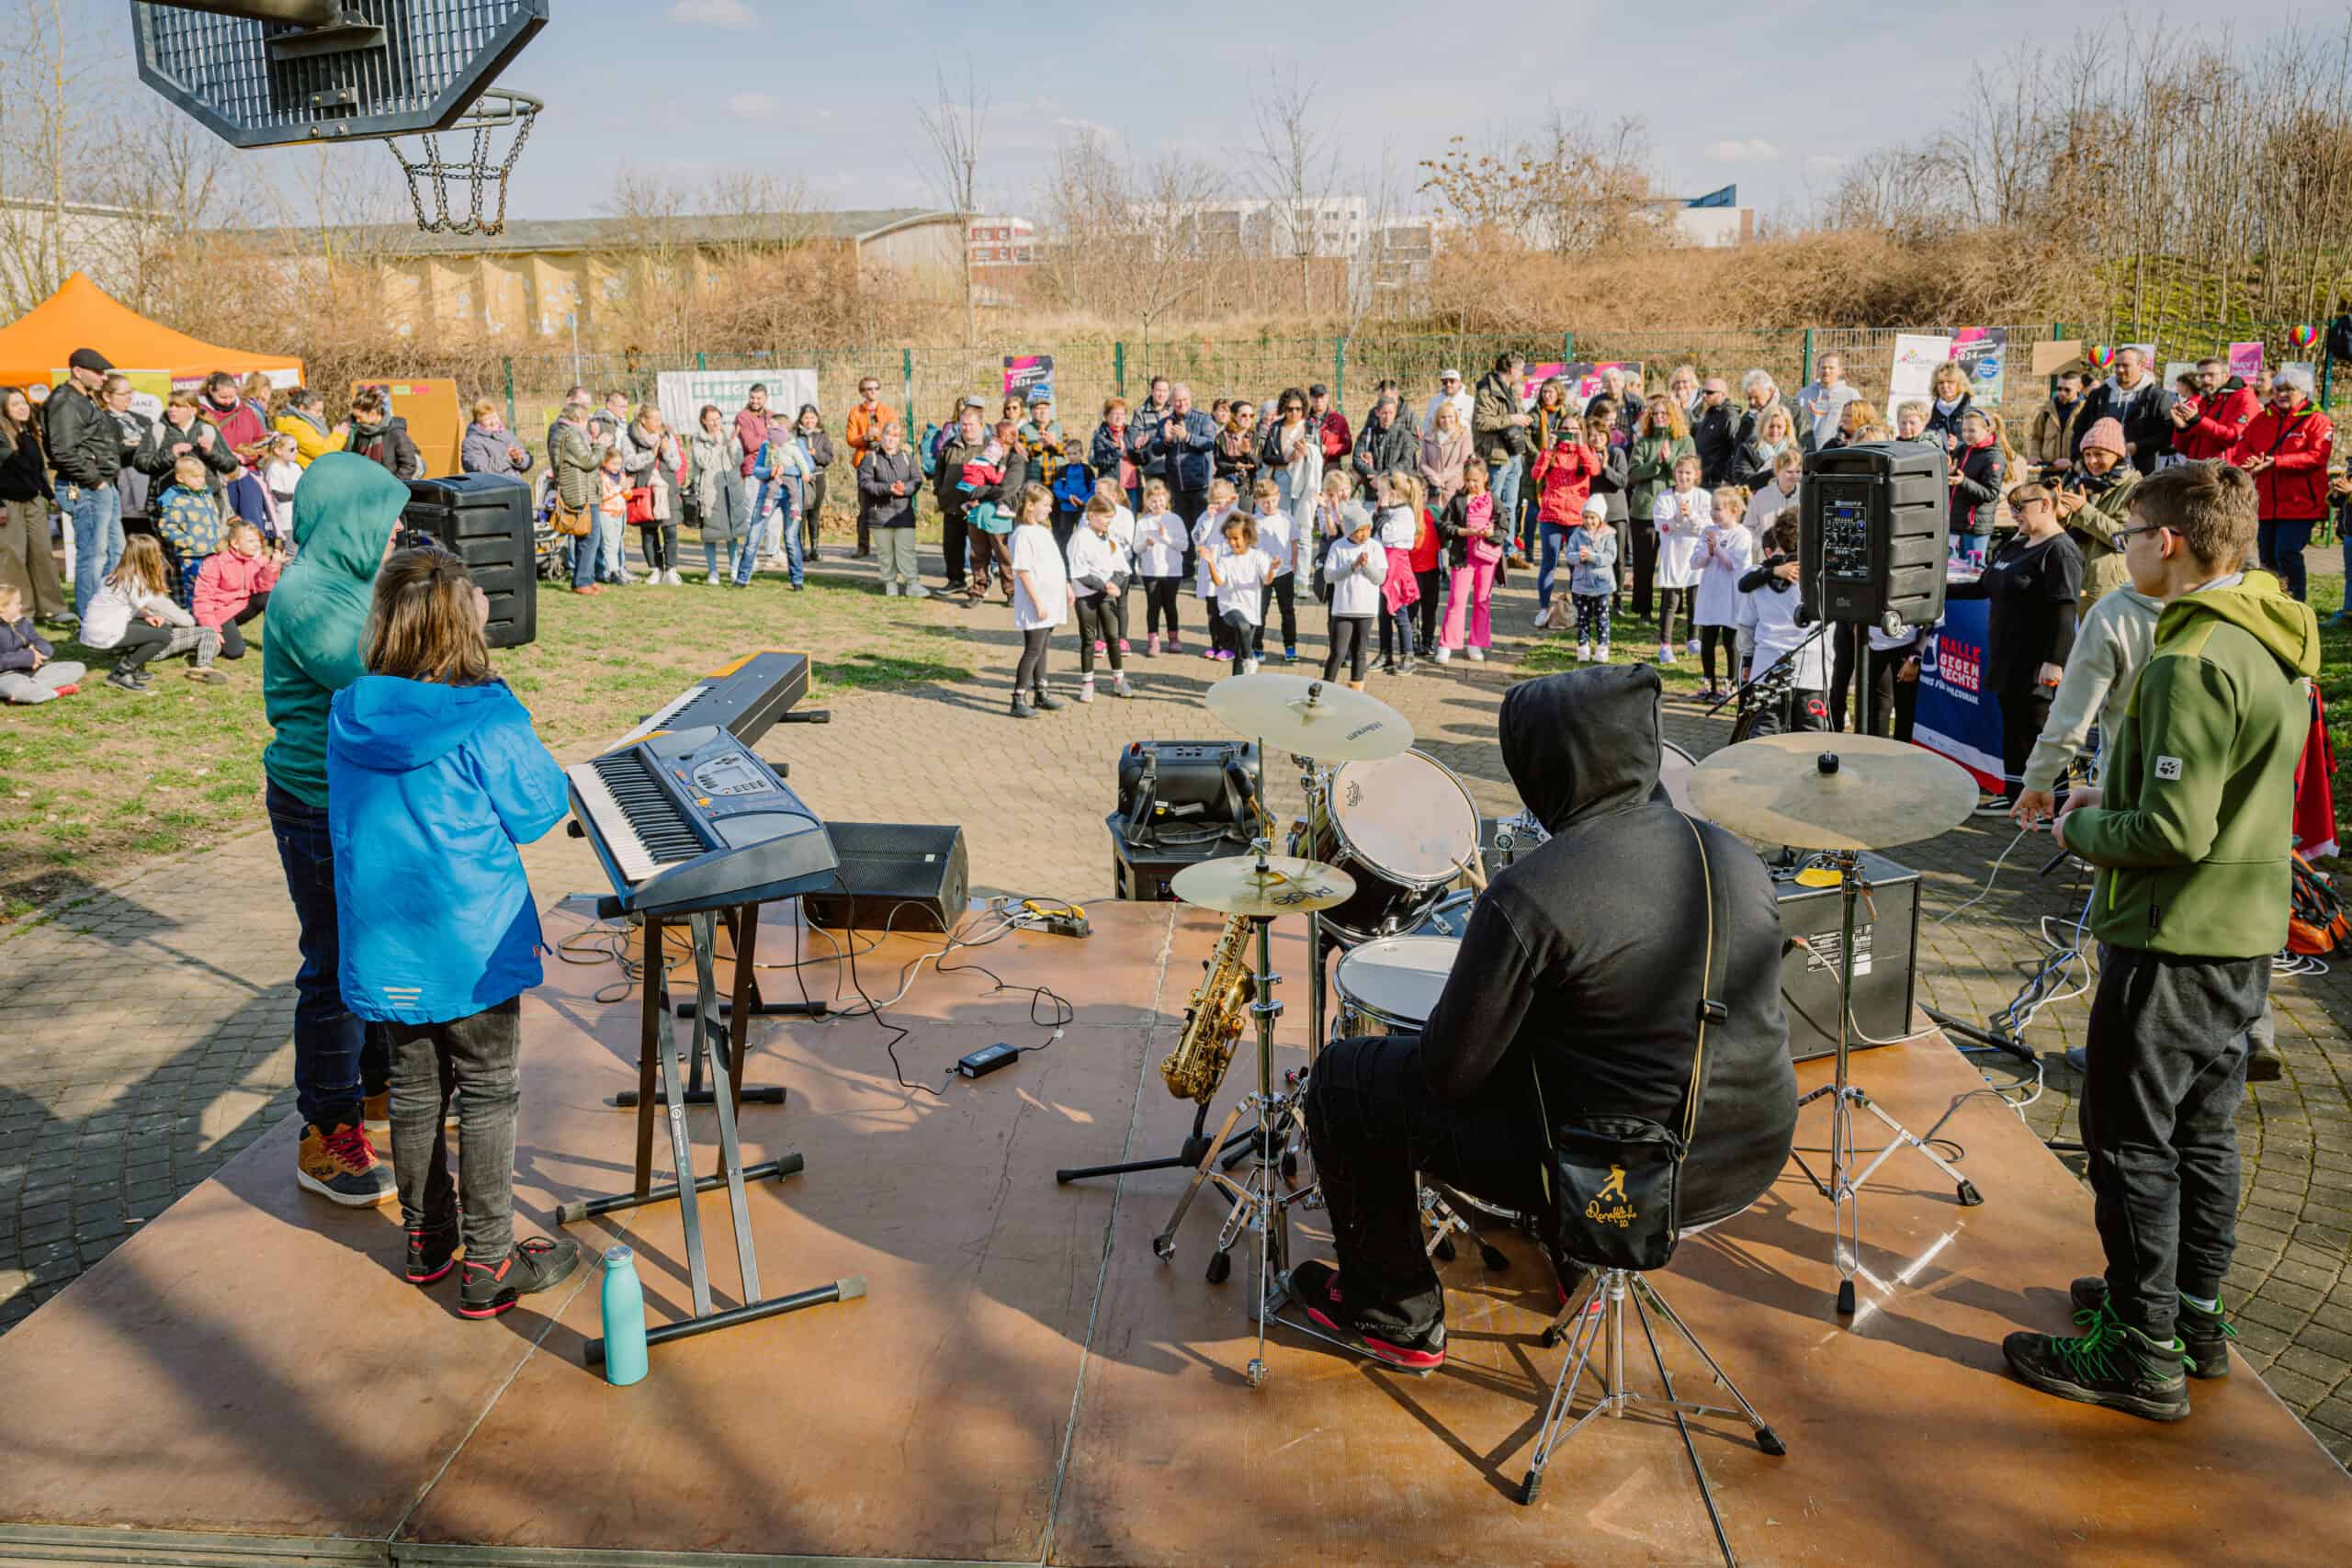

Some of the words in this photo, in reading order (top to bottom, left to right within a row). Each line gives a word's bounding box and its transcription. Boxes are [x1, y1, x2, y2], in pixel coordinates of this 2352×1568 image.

[1954, 351, 1978, 362] 2024
[1939, 634, 1982, 662] HALLE
[1939, 653, 1980, 677] GEGEN
[1939, 665, 1979, 691] RECHTS
